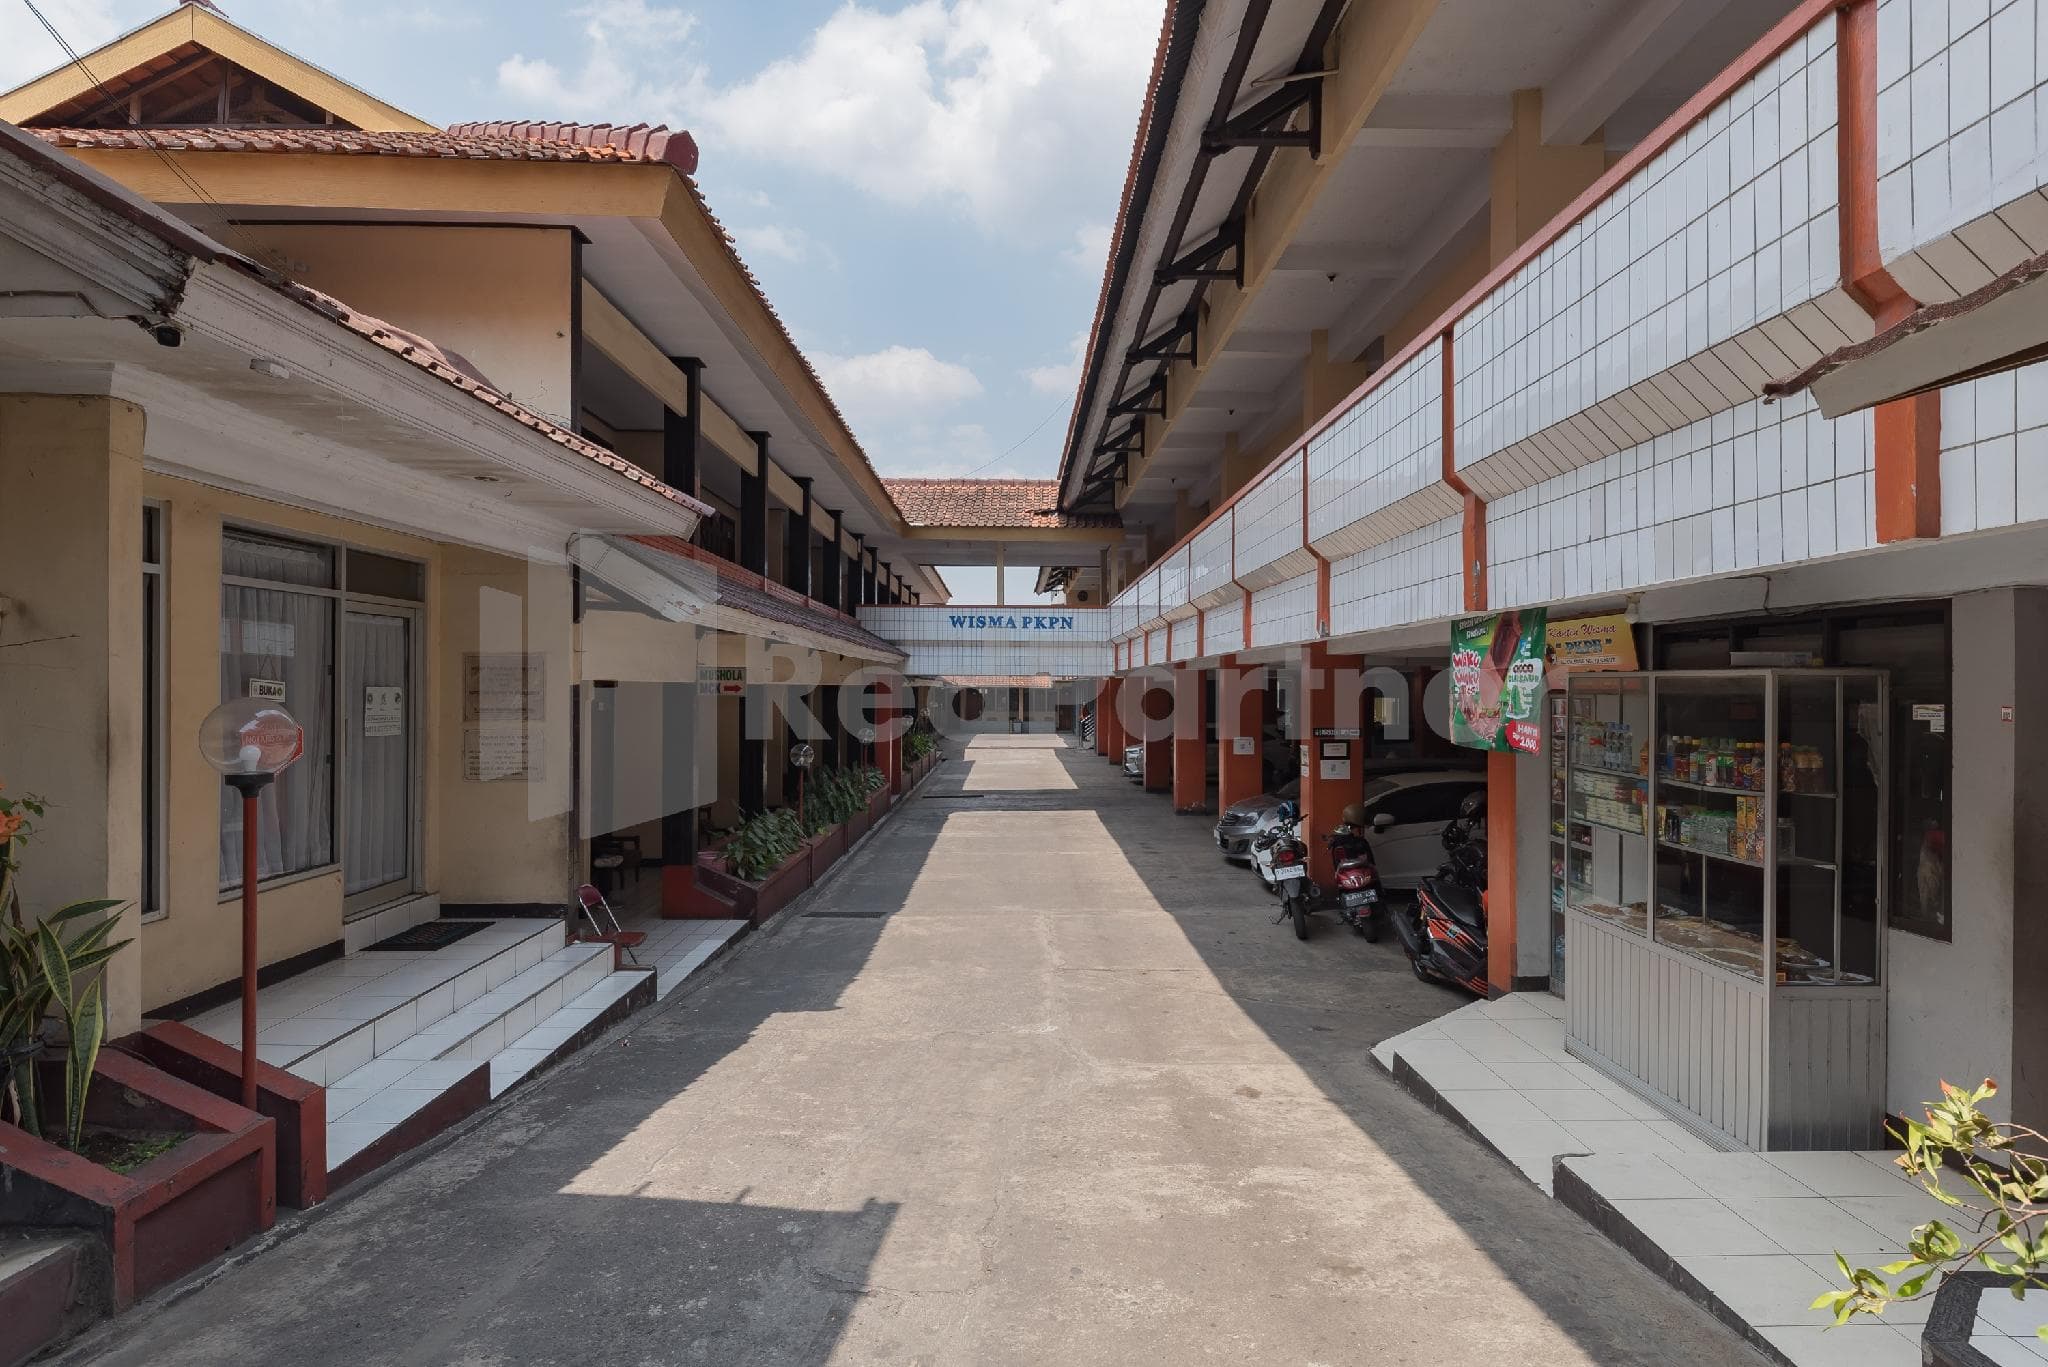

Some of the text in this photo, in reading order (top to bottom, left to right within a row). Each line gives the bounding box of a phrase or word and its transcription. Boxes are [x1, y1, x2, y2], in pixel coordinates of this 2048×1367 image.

[949, 615, 1073, 629] WISMA PKPN
[1581, 624, 1617, 635] Wisma
[700, 669, 743, 680] MUSHOLA
[259, 685, 276, 696] BUKA
